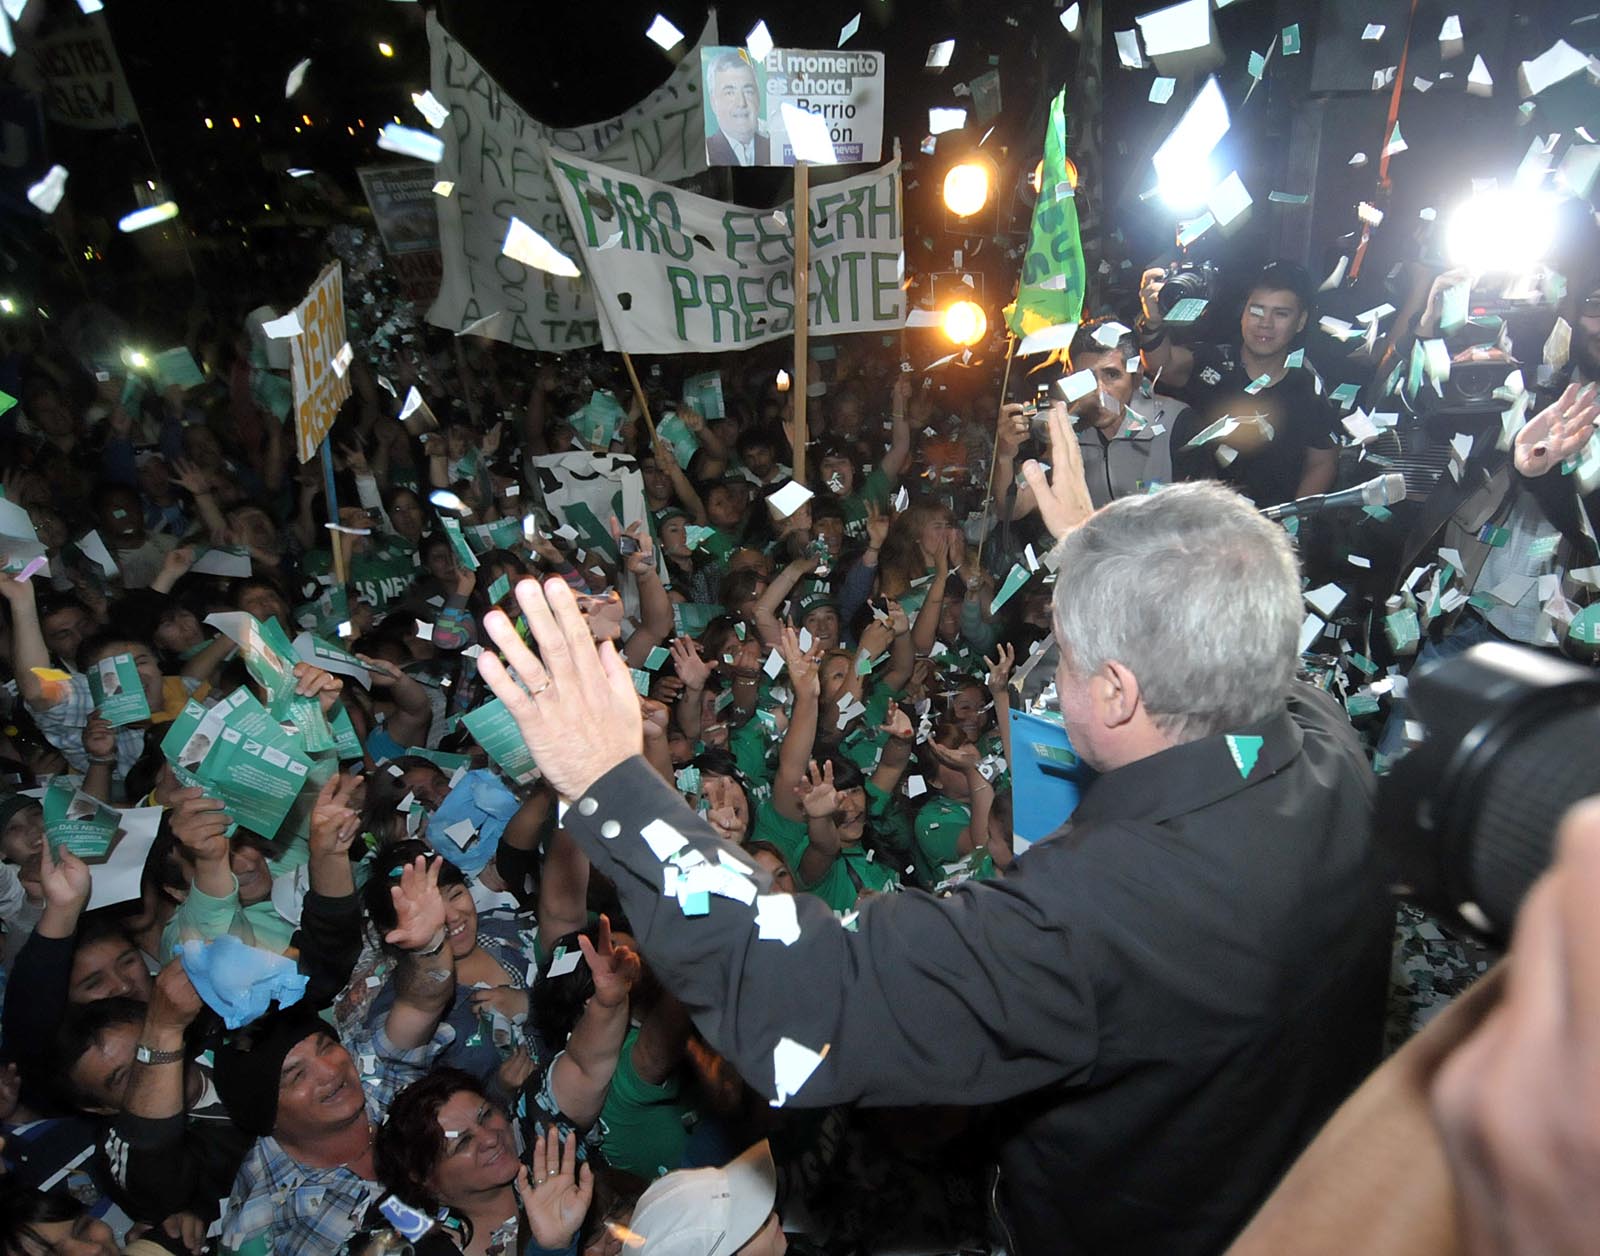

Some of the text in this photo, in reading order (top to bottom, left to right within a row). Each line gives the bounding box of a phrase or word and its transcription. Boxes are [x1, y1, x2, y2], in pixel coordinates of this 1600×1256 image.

[766, 52, 877, 74] El momento
[766, 75, 851, 95] es ahora.
[551, 157, 694, 262] TIRO
[667, 251, 900, 343] PRESNTE
